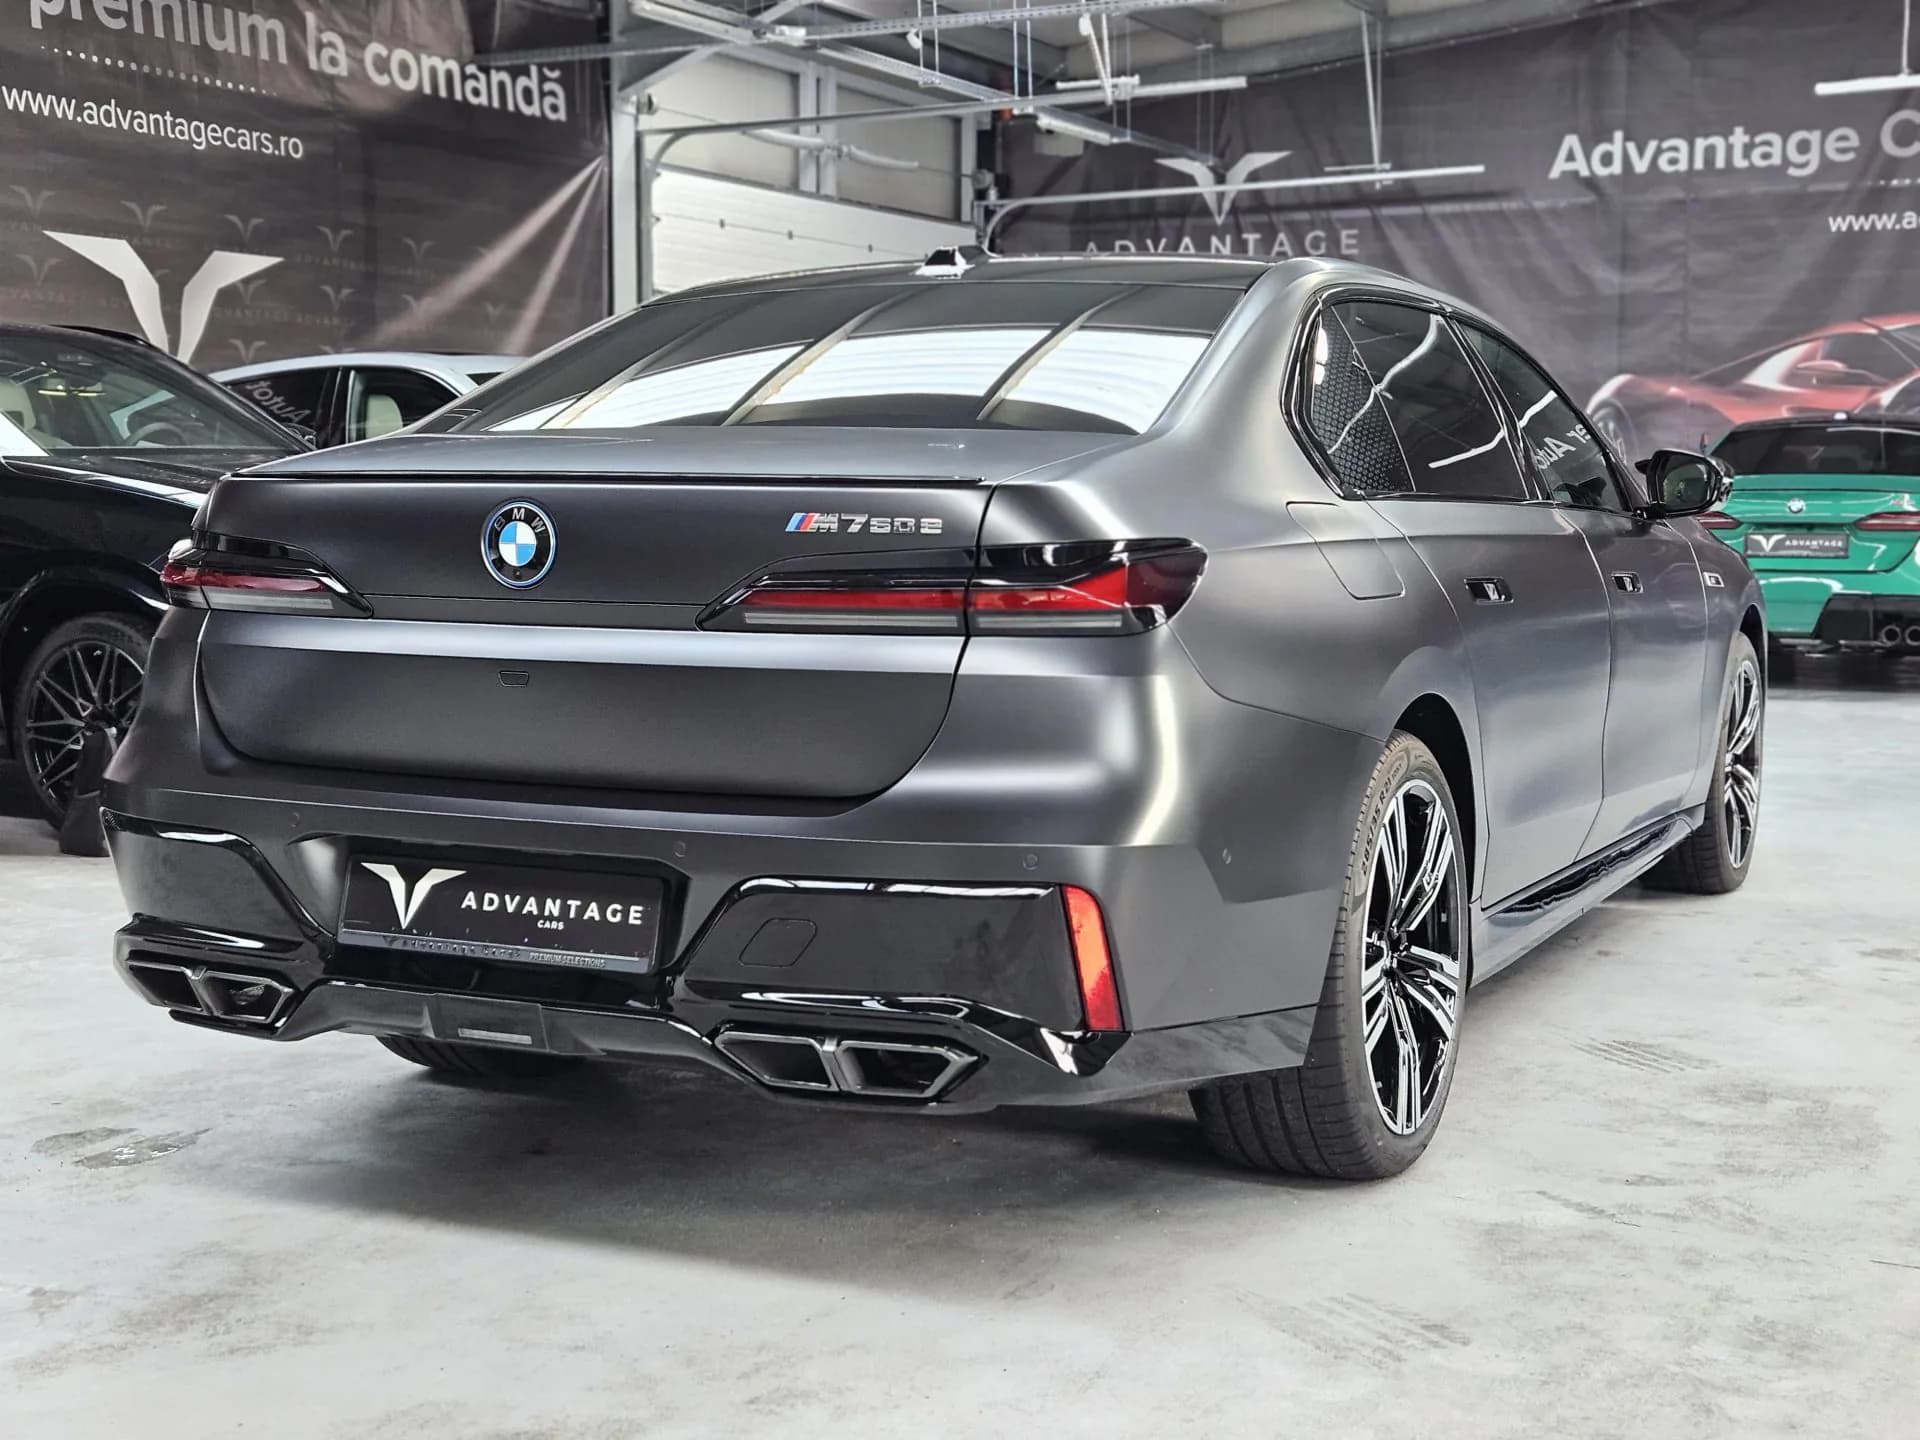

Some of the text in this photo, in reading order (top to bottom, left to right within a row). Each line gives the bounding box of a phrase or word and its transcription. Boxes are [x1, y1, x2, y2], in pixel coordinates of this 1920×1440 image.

[305, 11, 348, 77] la
[364, 41, 567, 122] comandă
[2, 85, 303, 159] www.advantagecars.ro
[1548, 126, 1861, 179] Advantage
[1828, 210, 1920, 233] www.a
[494, 507, 546, 533] BMW
[1784, 539, 1843, 547] ADVANTAGE
[461, 891, 644, 926] ADVANTAGE
[537, 919, 565, 930] CARS
